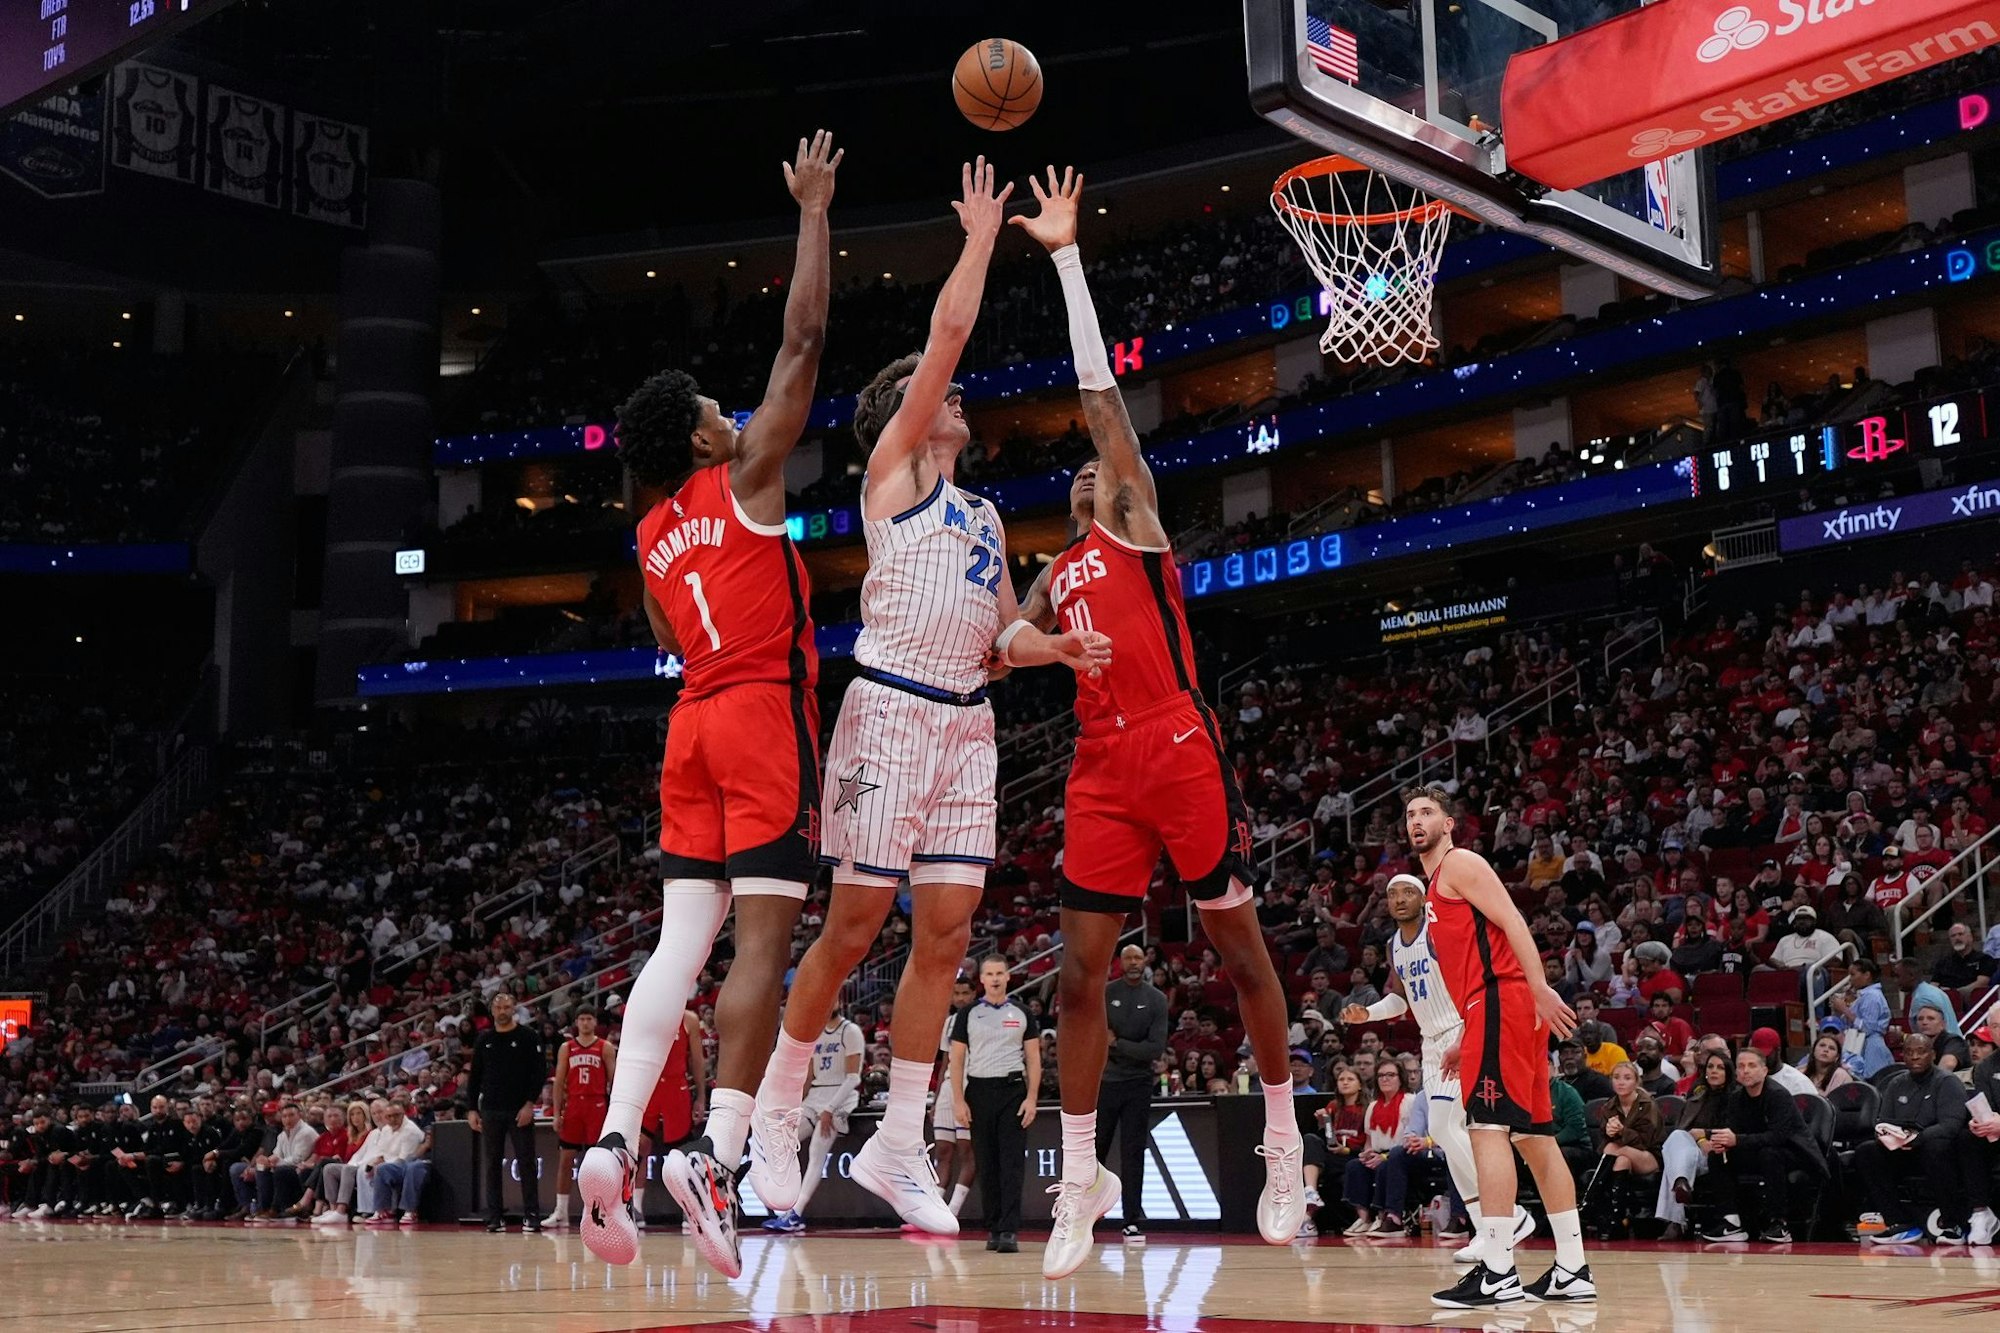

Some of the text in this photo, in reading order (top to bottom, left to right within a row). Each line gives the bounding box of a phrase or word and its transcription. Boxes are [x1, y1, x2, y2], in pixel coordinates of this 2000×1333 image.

[1959, 94, 1990, 130] D
[1114, 336, 1144, 376] K
[1928, 402, 1961, 448] 12
[1750, 441, 1770, 461] FLS
[1756, 460, 1766, 483] 1
[1794, 451, 1804, 475] 1
[1822, 504, 1903, 540] xfinity
[645, 516, 727, 581] THOMPSON
[683, 571, 721, 652] 1
[1380, 596, 1508, 631] MEMORIAL HERMANN
[1409, 979, 1428, 1002] 34
[578, 1067, 590, 1085] 15
